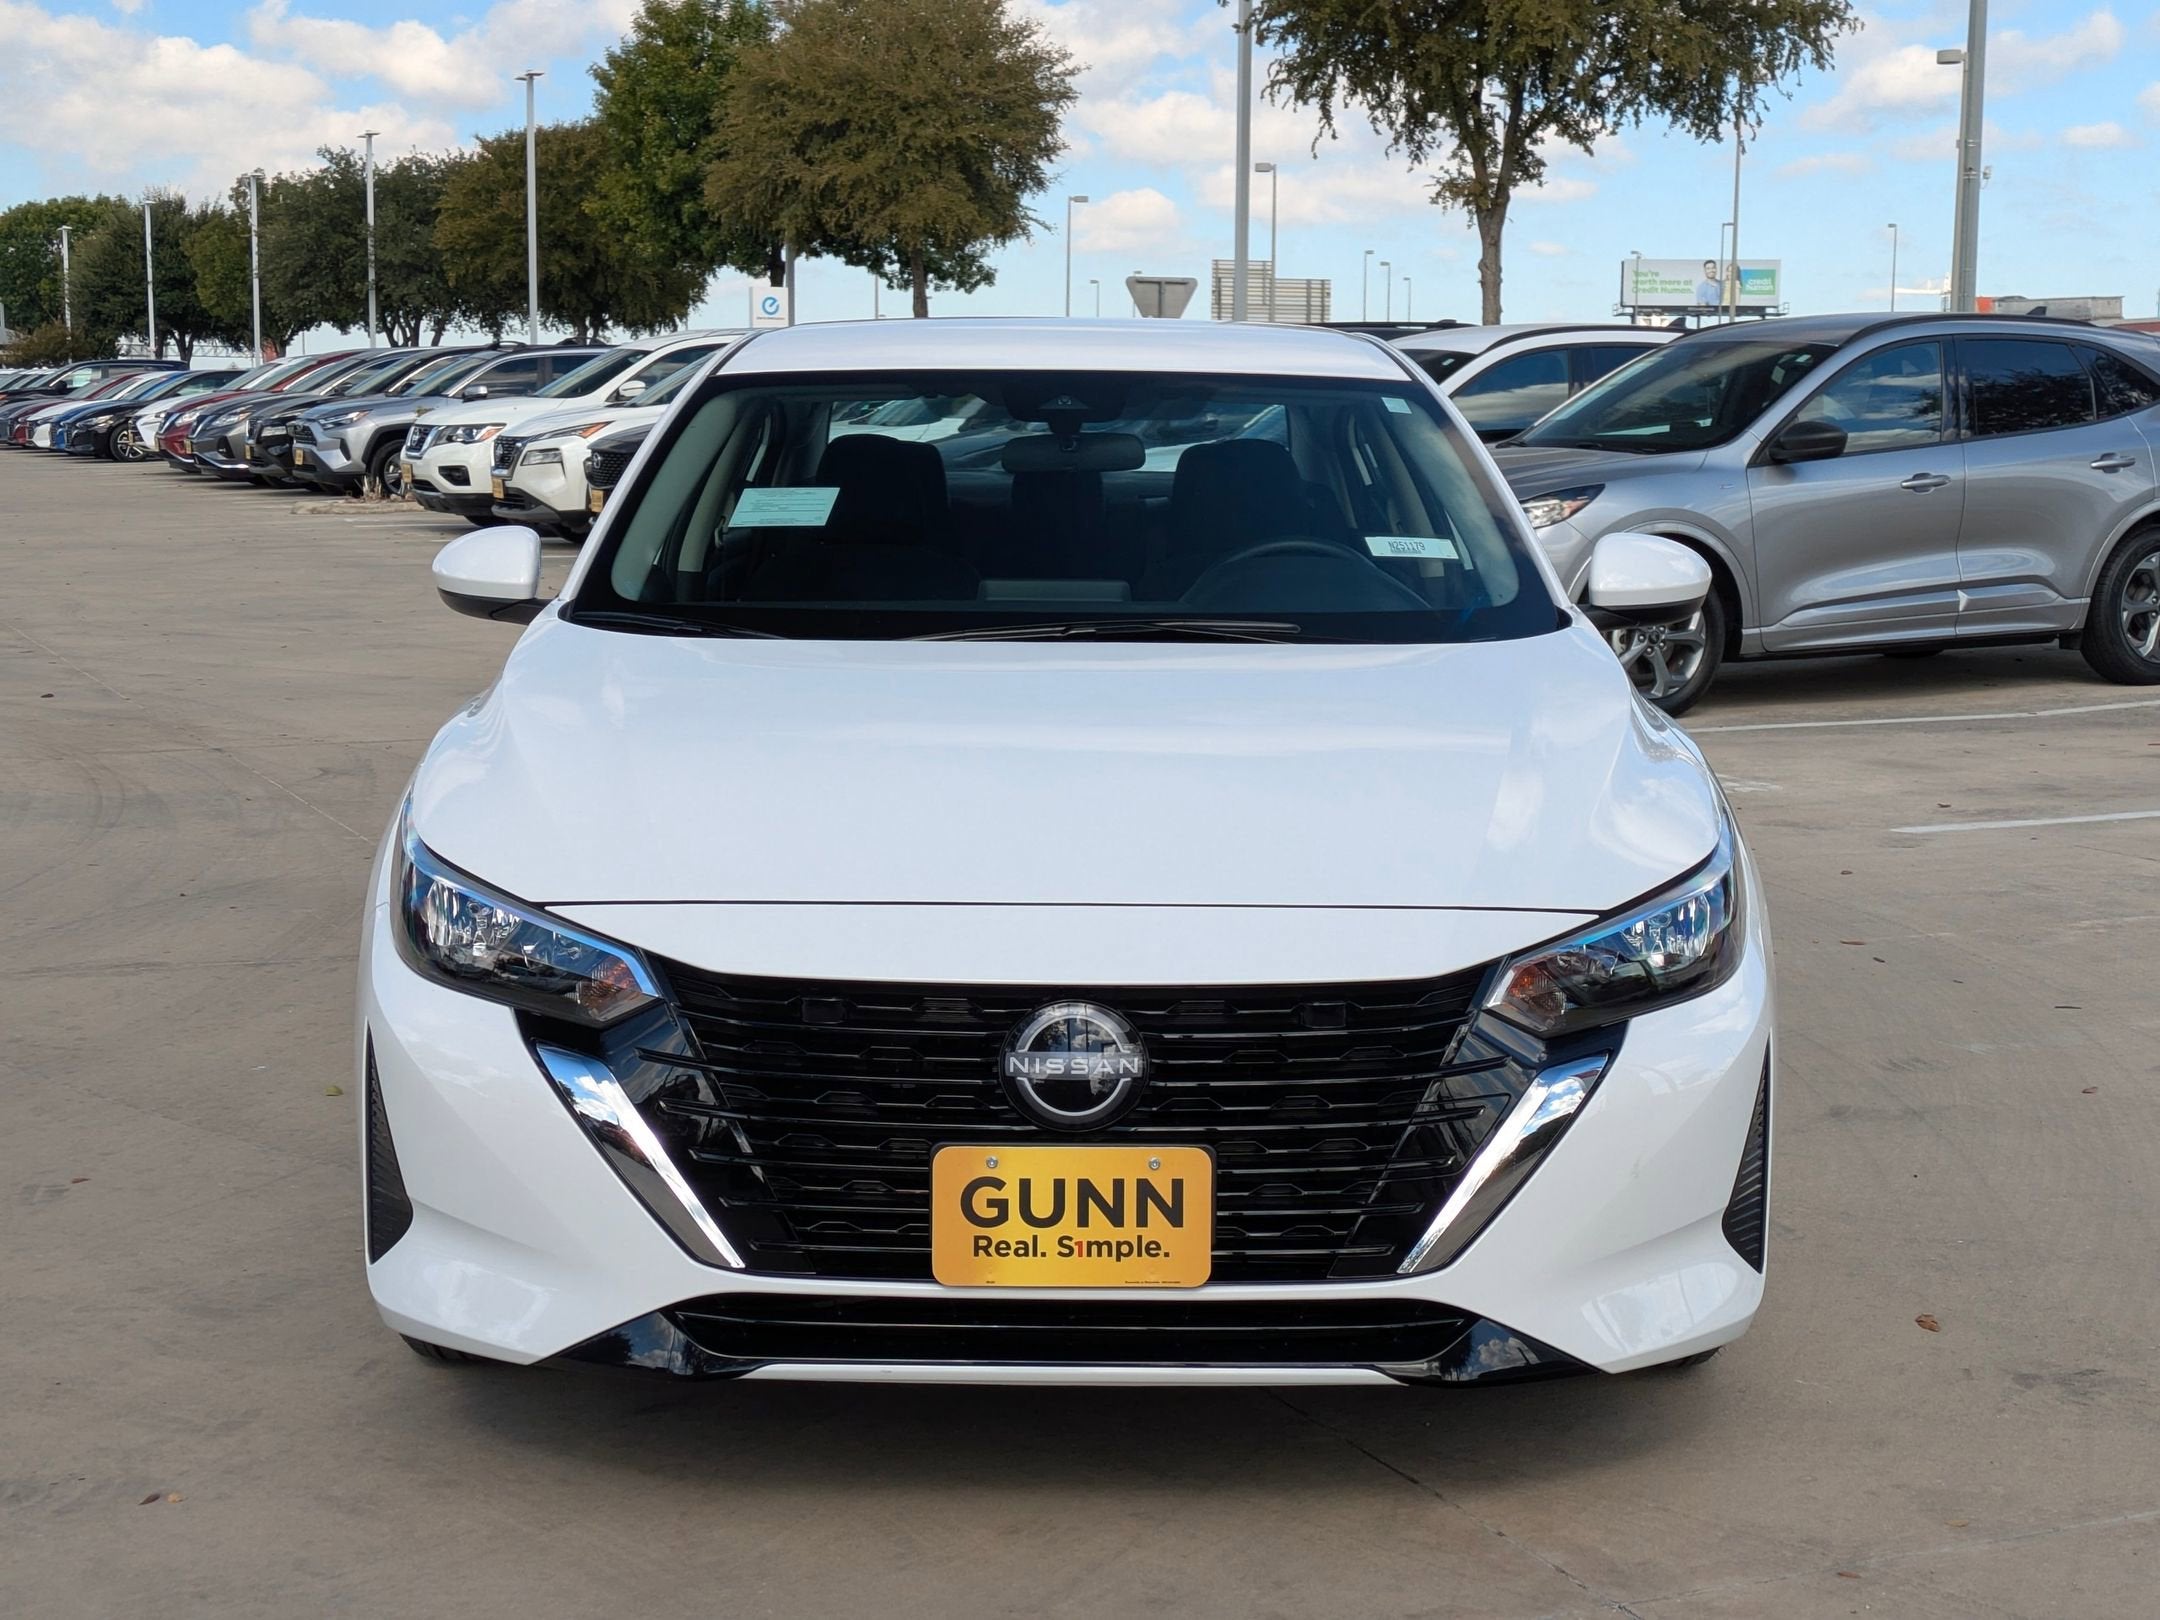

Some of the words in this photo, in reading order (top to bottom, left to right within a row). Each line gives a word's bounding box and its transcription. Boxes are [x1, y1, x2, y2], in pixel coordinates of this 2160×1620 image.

[1632, 286, 1659, 294] Credit
[1683, 278, 1693, 286] at
[1009, 1056, 1139, 1075] NISSAN
[960, 1176, 1184, 1228] GUNN
[973, 1235, 1047, 1258] Real.
